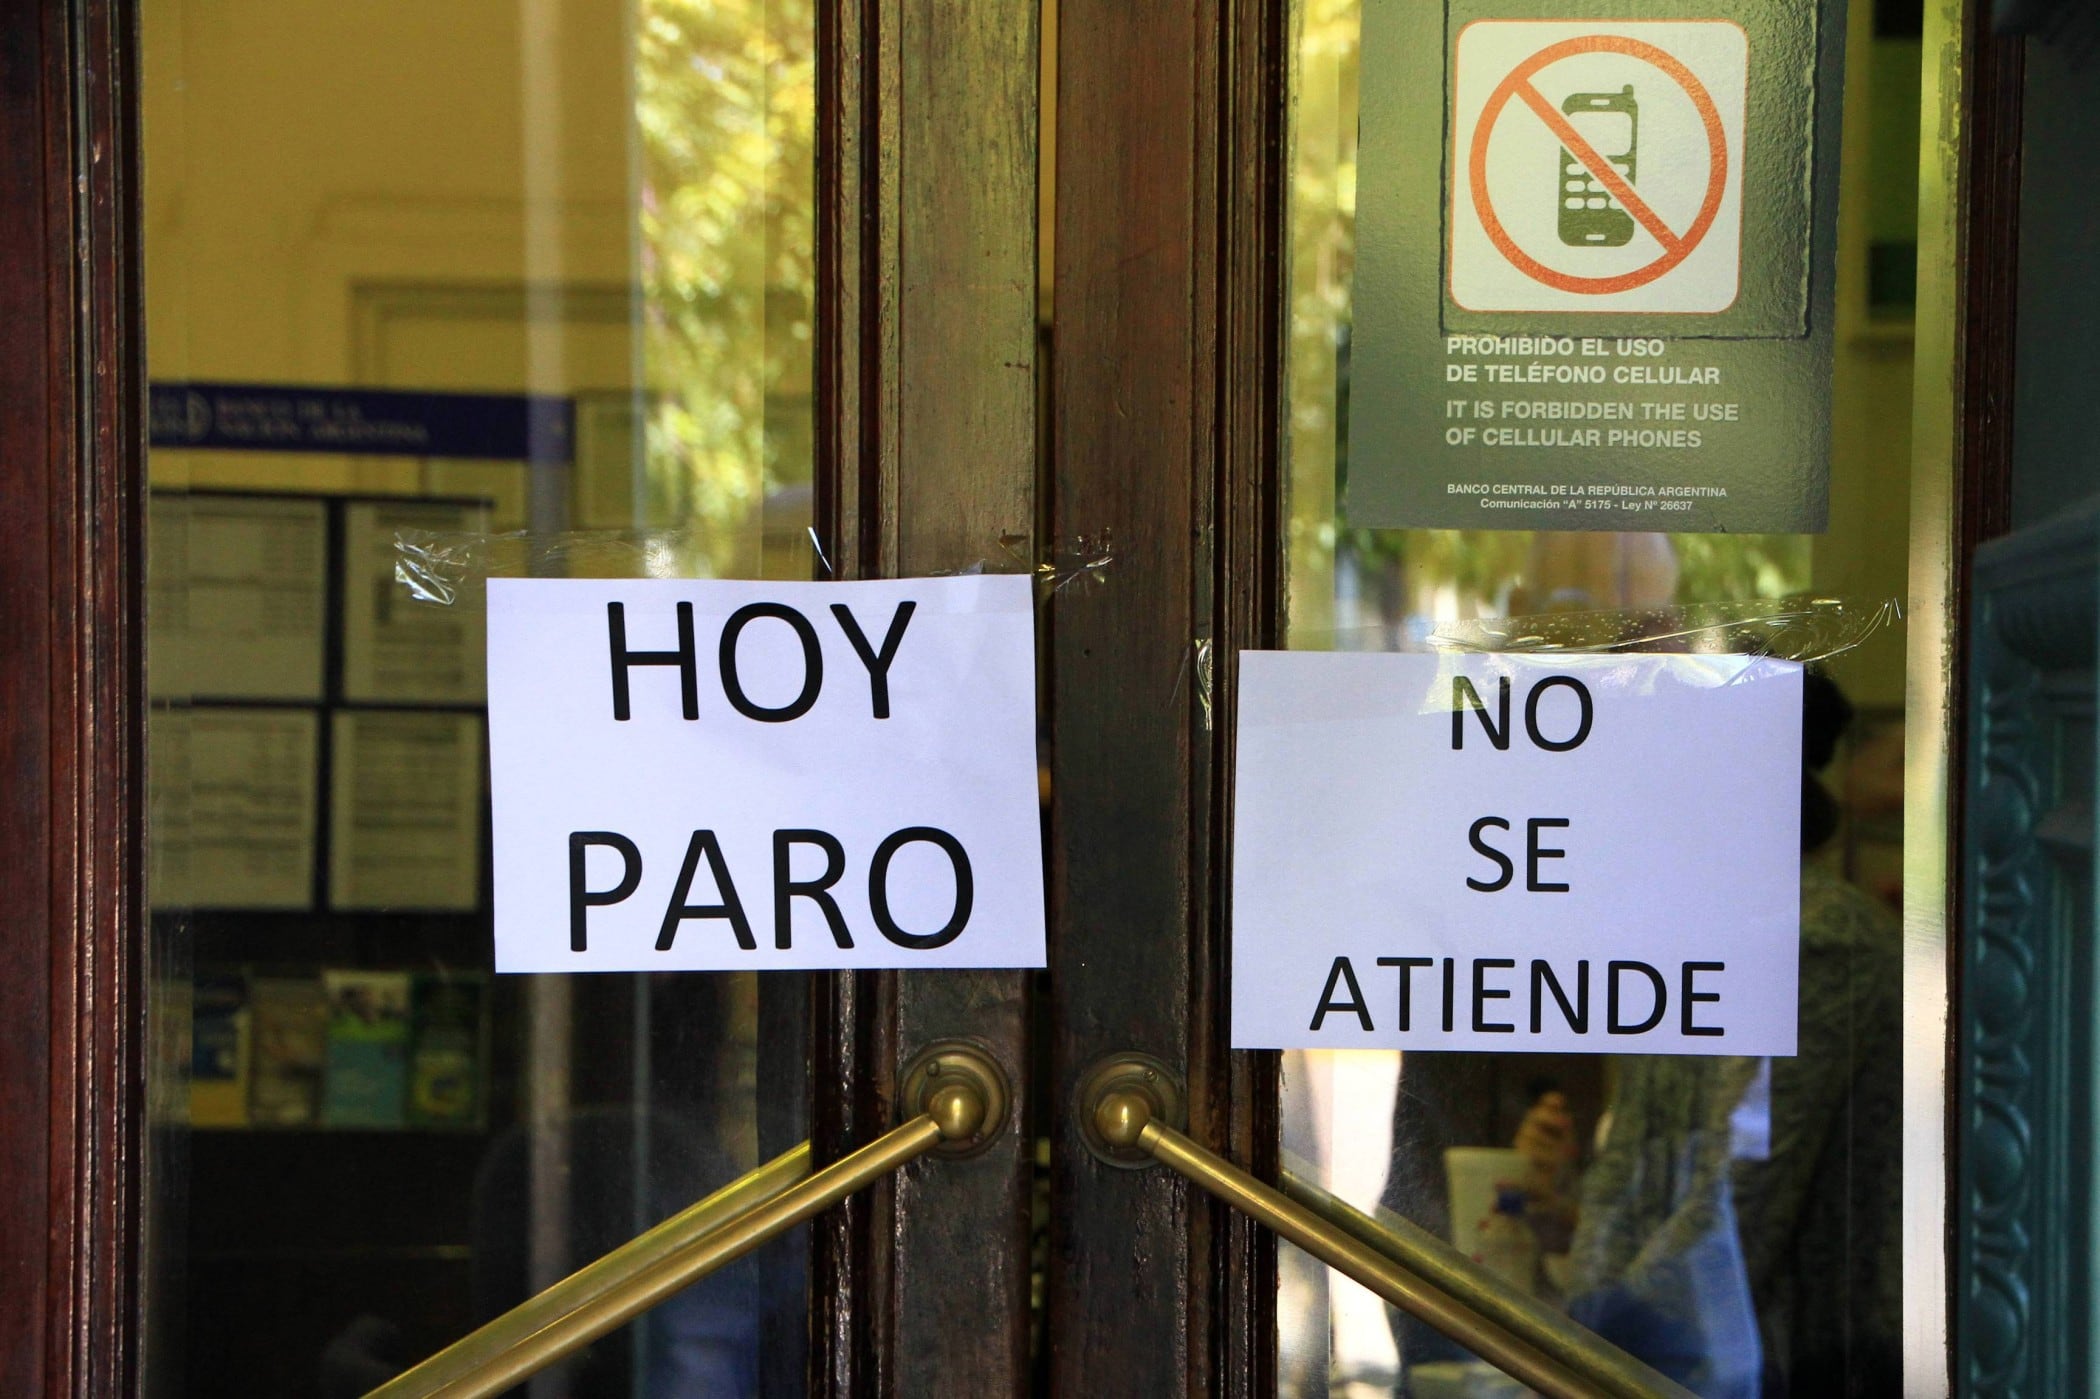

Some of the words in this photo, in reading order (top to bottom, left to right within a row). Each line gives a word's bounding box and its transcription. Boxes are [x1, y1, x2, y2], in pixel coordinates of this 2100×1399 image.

[1447, 337, 1574, 356] PROHIBIDO
[1581, 338, 1610, 356] EL
[1616, 339, 1665, 357] USO
[1446, 364, 1477, 382] DE
[1484, 361, 1606, 384] TELÉFONO
[1613, 366, 1720, 385] CELULAR
[1446, 400, 1467, 418] IT
[1473, 400, 1495, 419] IS
[1501, 401, 1633, 420] FORBIDDEN
[1641, 402, 1686, 420] THE
[1693, 403, 1739, 421] USE
[1445, 427, 1476, 445] OF
[1482, 428, 1601, 447] CELLULAR
[1607, 430, 1702, 448] PHONES
[1447, 484, 1490, 495] BANCO
[1492, 484, 1548, 495] CENTRAL
[1550, 485, 1567, 495] DE
[1569, 486, 1585, 496] LA
[1588, 483, 1656, 496] REPÚBLICA
[1658, 486, 1727, 497] ARGENTINA
[1480, 498, 1560, 509] Comunicación
[1584, 500, 1611, 510] 5175
[1621, 501, 1641, 512] Ley
[1660, 501, 1693, 511] 26637
[607, 601, 917, 723] HOY
[1451, 675, 1594, 753] NO
[1466, 816, 1570, 893] SE
[568, 826, 974, 953] PARO
[1309, 956, 1726, 1037] ATIENDE
